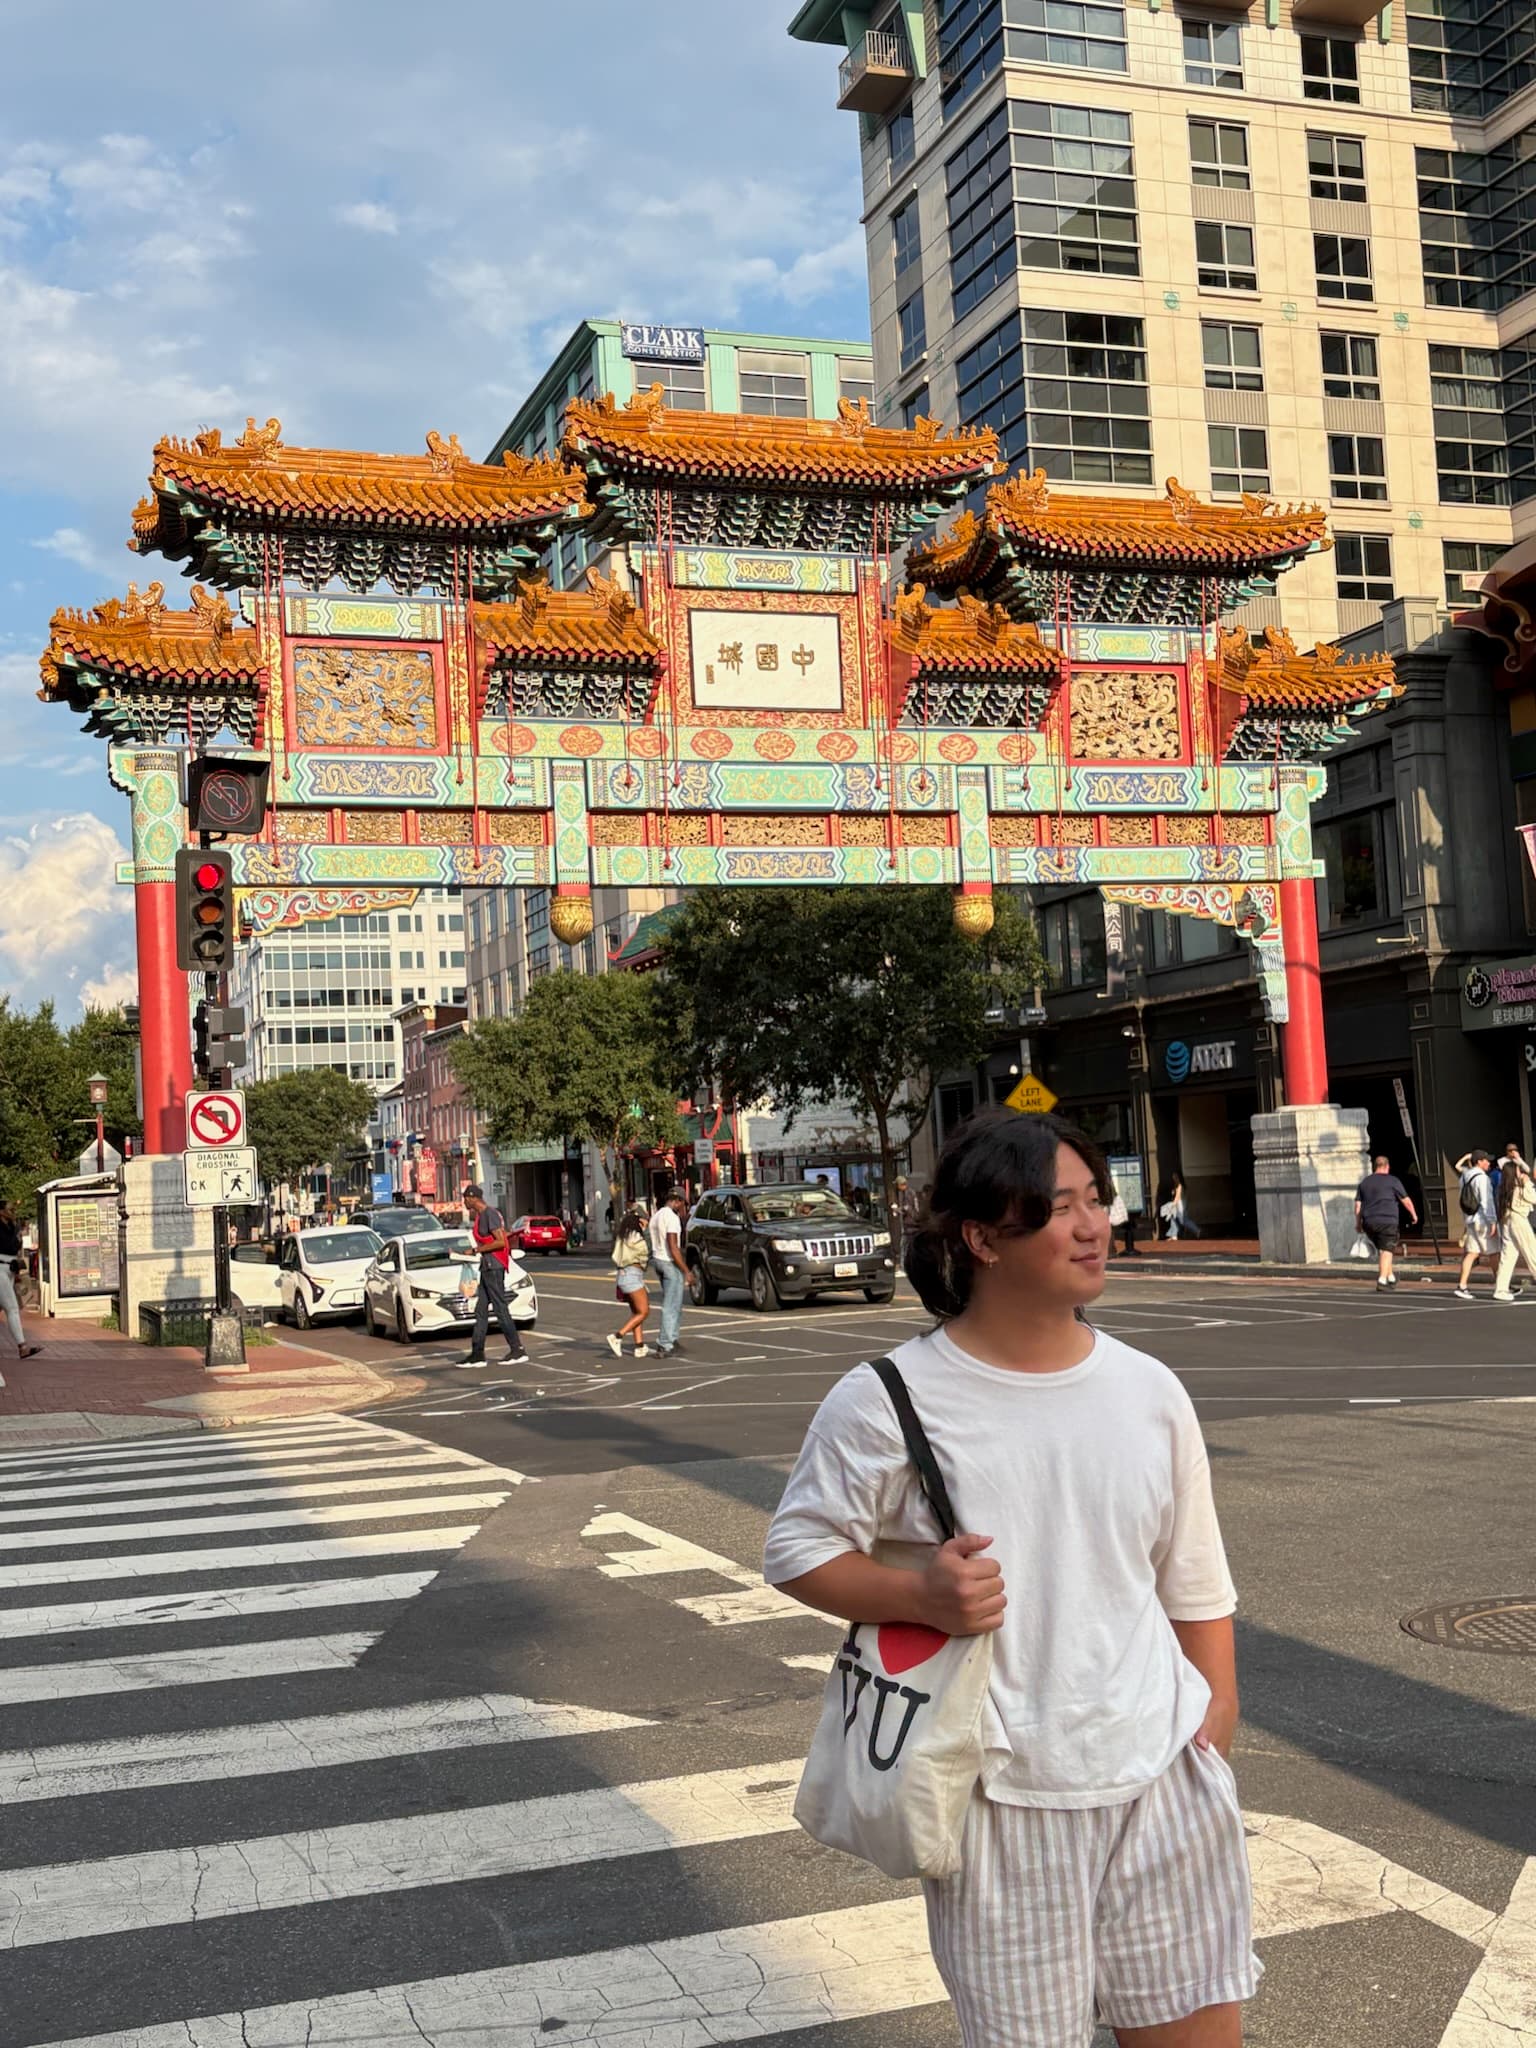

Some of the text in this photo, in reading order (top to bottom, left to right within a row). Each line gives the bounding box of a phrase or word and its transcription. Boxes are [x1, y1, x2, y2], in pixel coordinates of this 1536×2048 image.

[626, 326, 702, 349] CLARK
[627, 346, 703, 358] CONSTRUCTION
[1191, 1041, 1235, 1072] AT&T
[1020, 1087, 1040, 1097] LEFT
[1020, 1098, 1042, 1108] LANE
[197, 1152, 240, 1161] DIAGONAL
[196, 1160, 239, 1169] CROSSING
